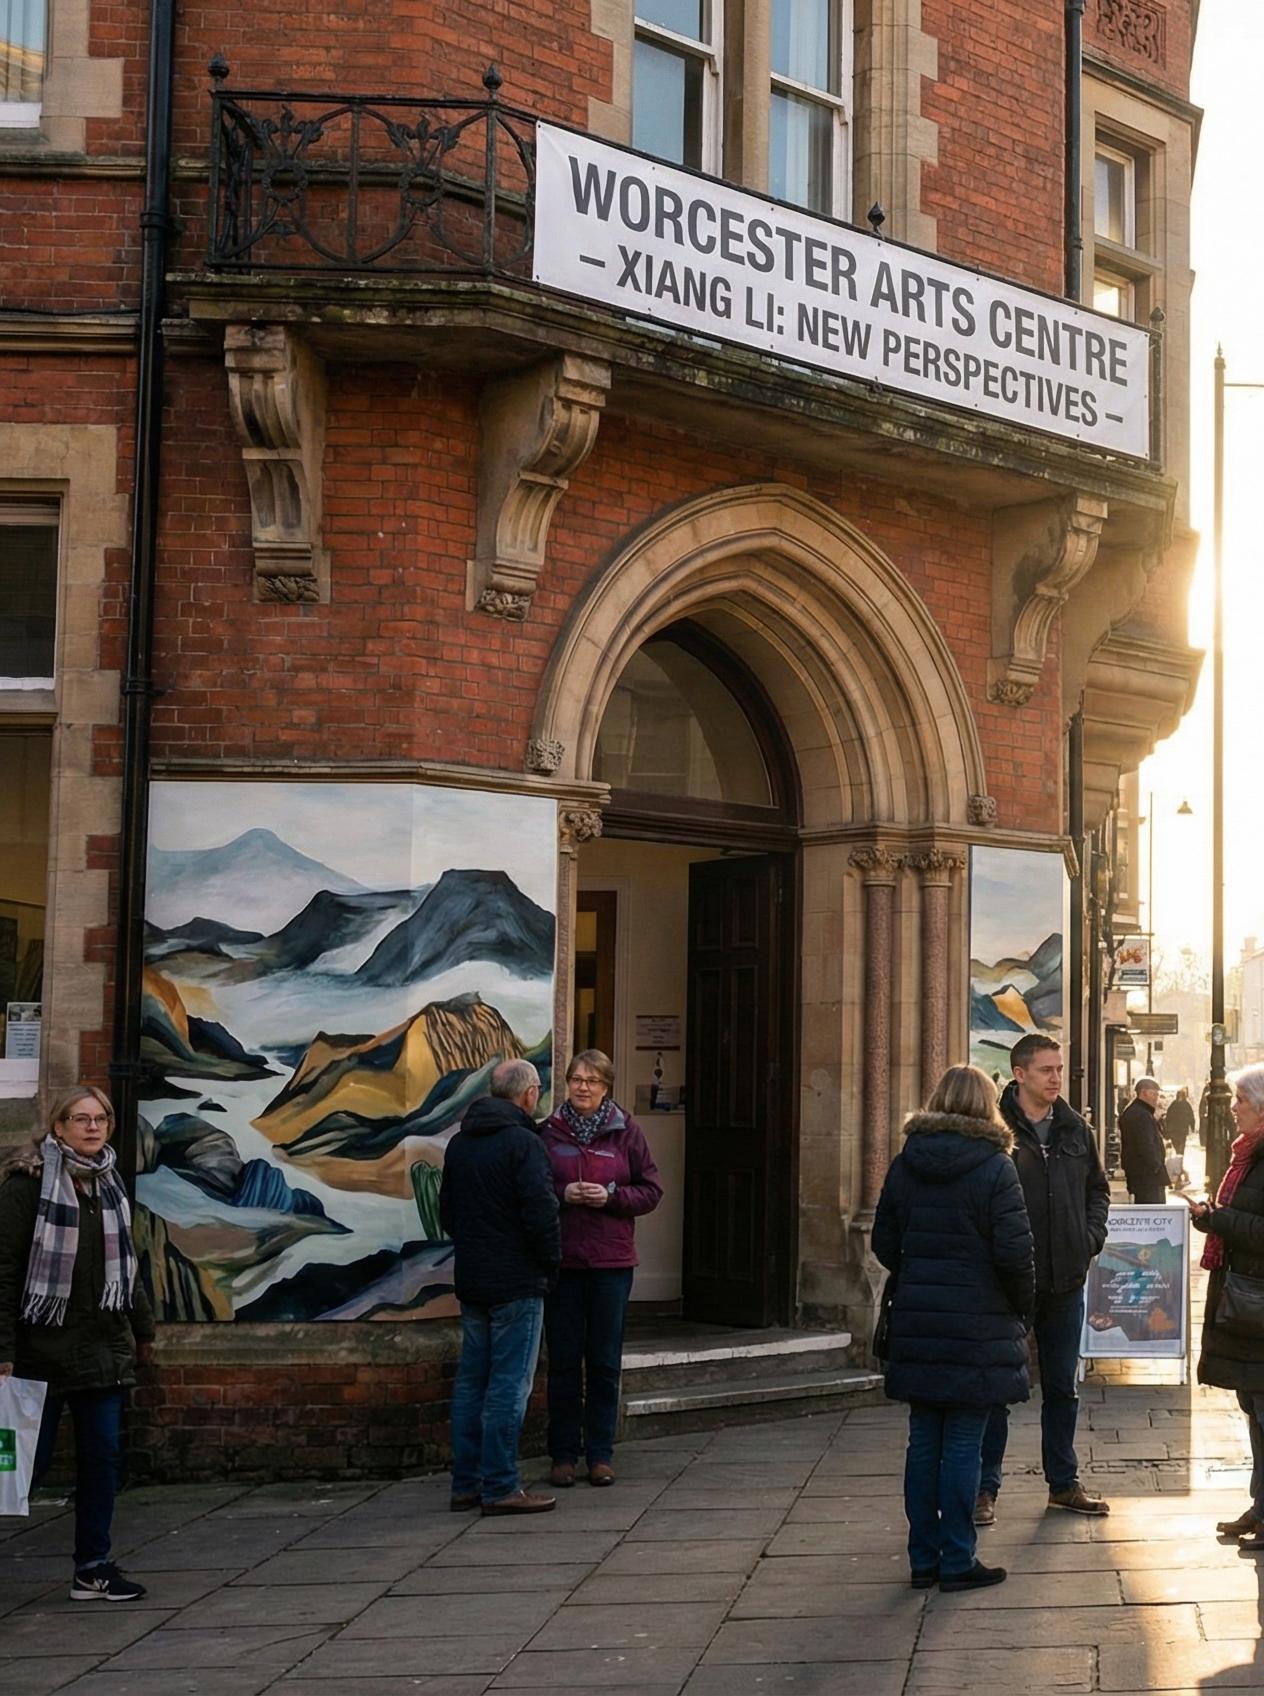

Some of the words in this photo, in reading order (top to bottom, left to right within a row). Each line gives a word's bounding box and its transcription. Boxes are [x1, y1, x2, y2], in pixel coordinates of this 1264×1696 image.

[567, 155, 858, 302] WORCESTER
[870, 261, 976, 337] ARTS
[989, 299, 1128, 387] CENTRE
[615, 244, 732, 320] XIANG
[745, 286, 785, 336] LI:
[797, 302, 872, 361] NEW
[882, 328, 1098, 427] PERSPECTIVES
